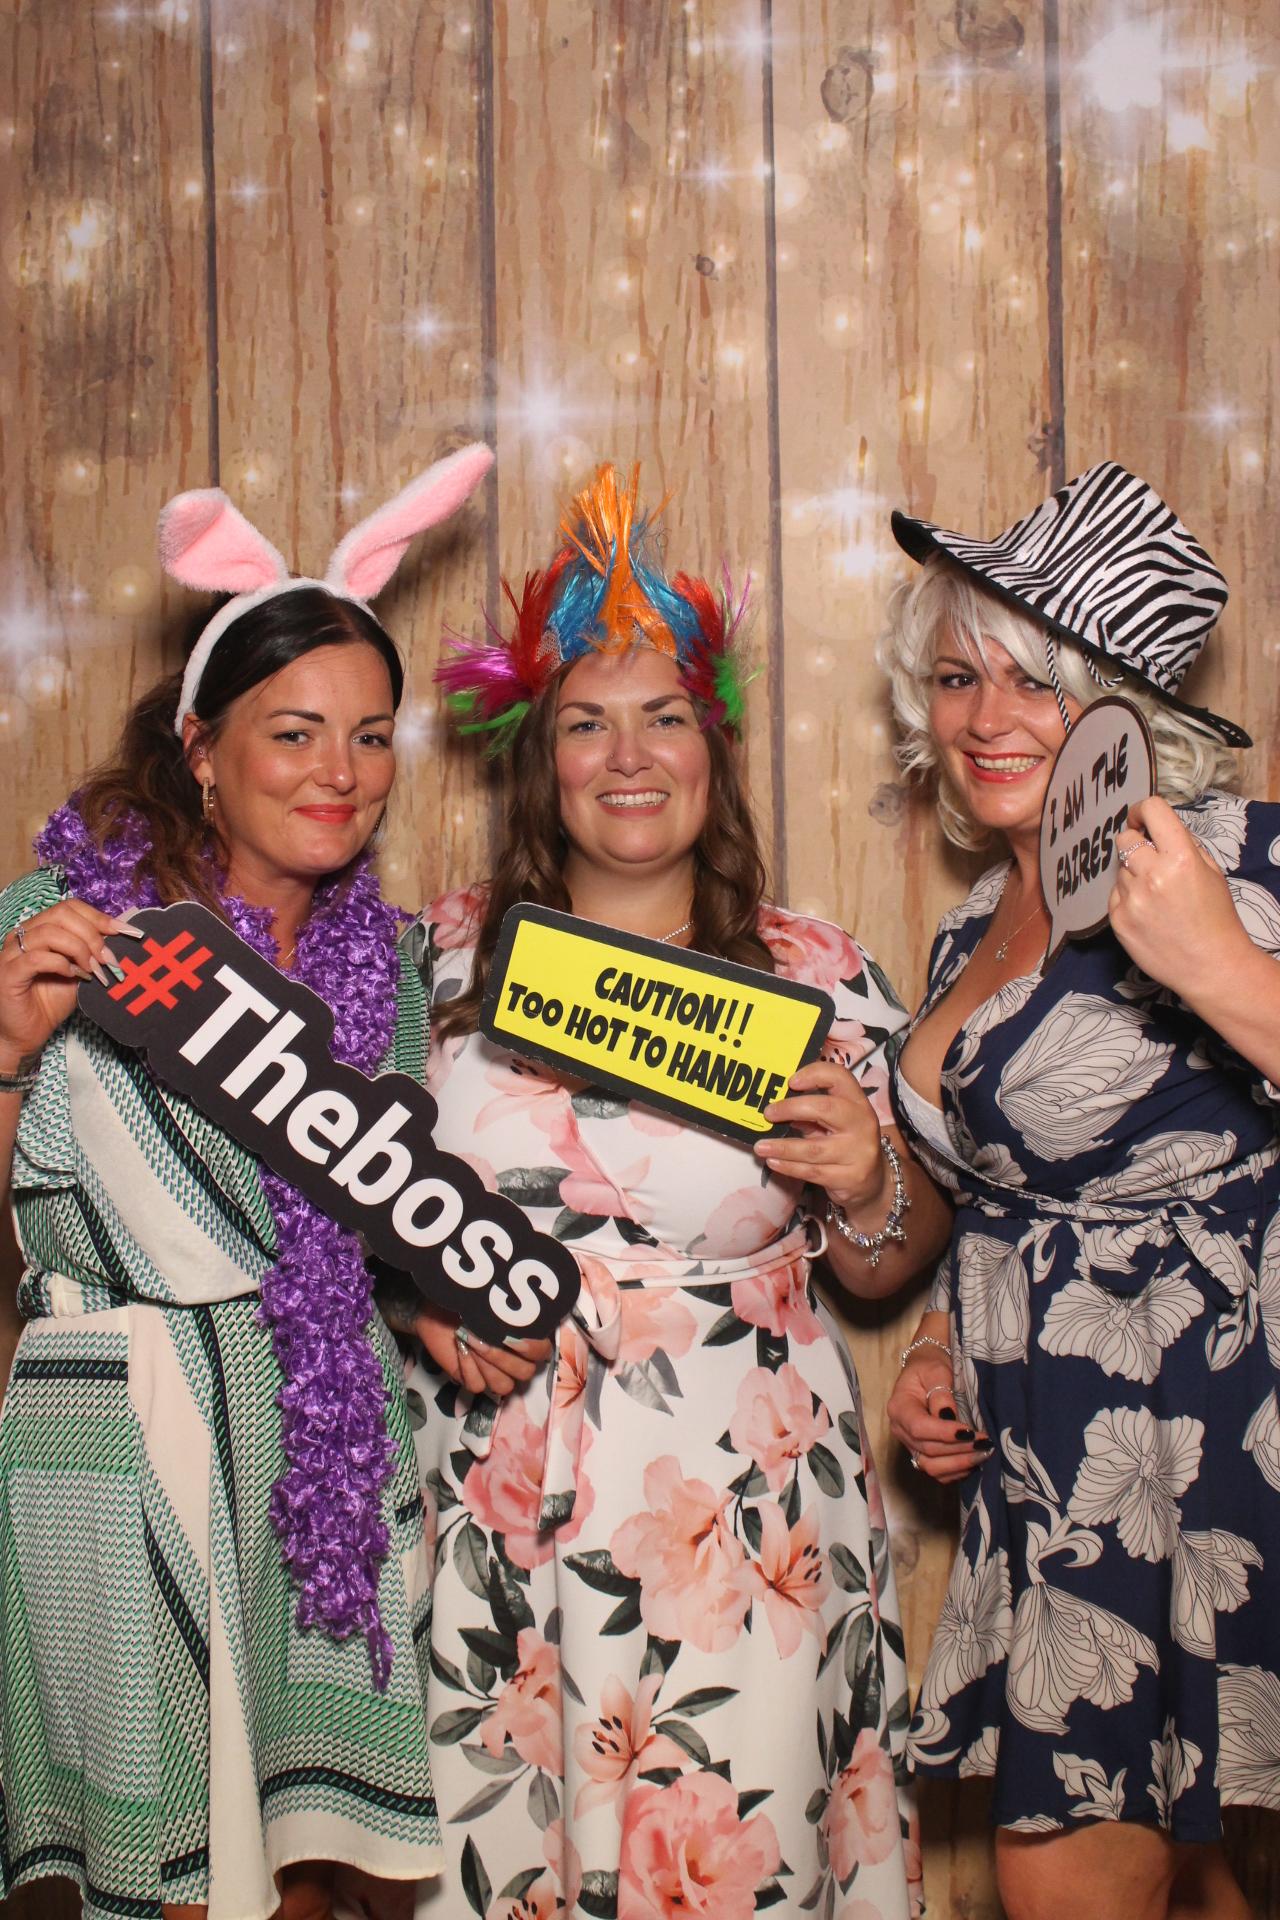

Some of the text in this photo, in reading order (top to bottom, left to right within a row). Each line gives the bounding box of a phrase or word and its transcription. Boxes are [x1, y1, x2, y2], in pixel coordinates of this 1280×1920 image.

[1049, 733, 1128, 848] I AM THE
[508, 983, 785, 1113] TOO HOT TO HANDLE
[594, 967, 755, 1049] CAUTION!!
[107, 930, 559, 1327] #Theboss
